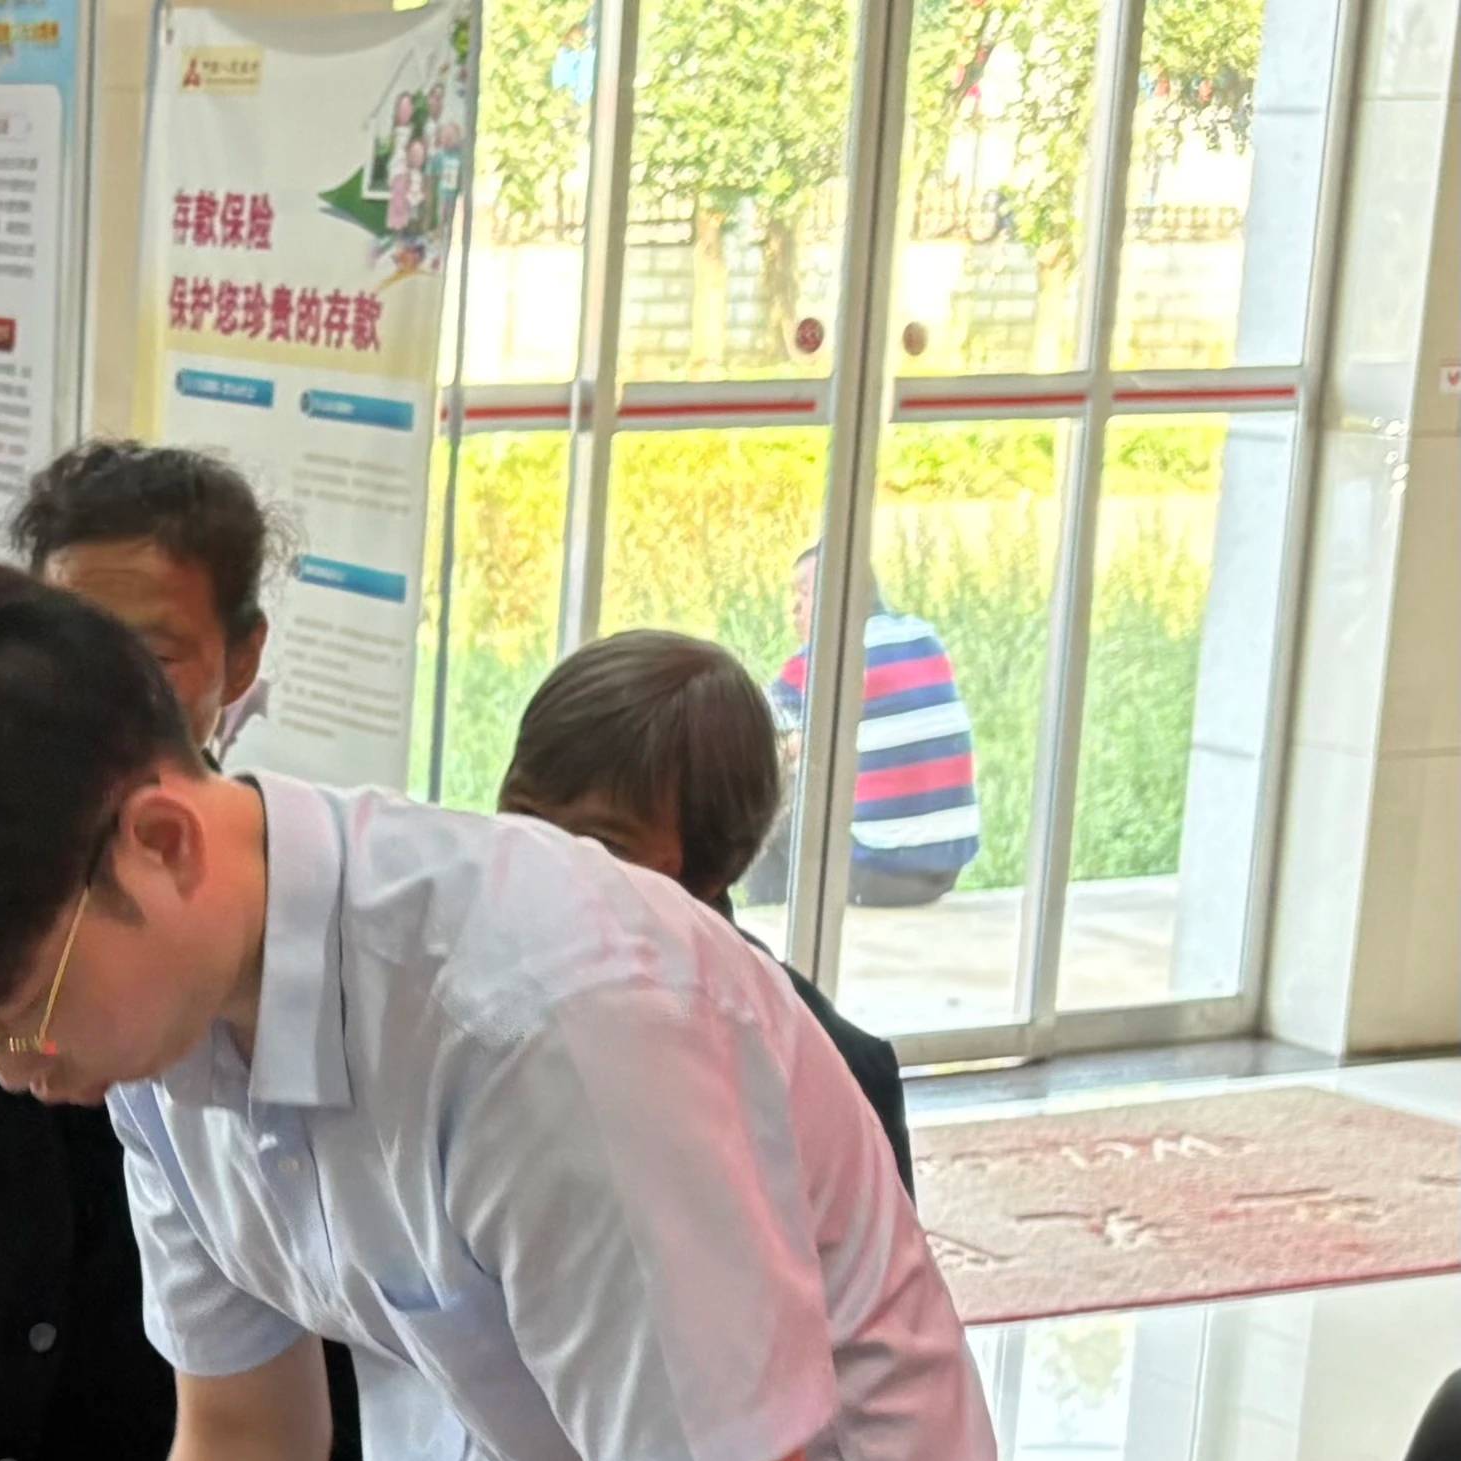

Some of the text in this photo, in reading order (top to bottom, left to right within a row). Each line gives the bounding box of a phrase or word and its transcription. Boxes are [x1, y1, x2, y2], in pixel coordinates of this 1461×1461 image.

[173, 188, 275, 250] 存款保险
[169, 274, 384, 352] 保护您珍贵的存款
